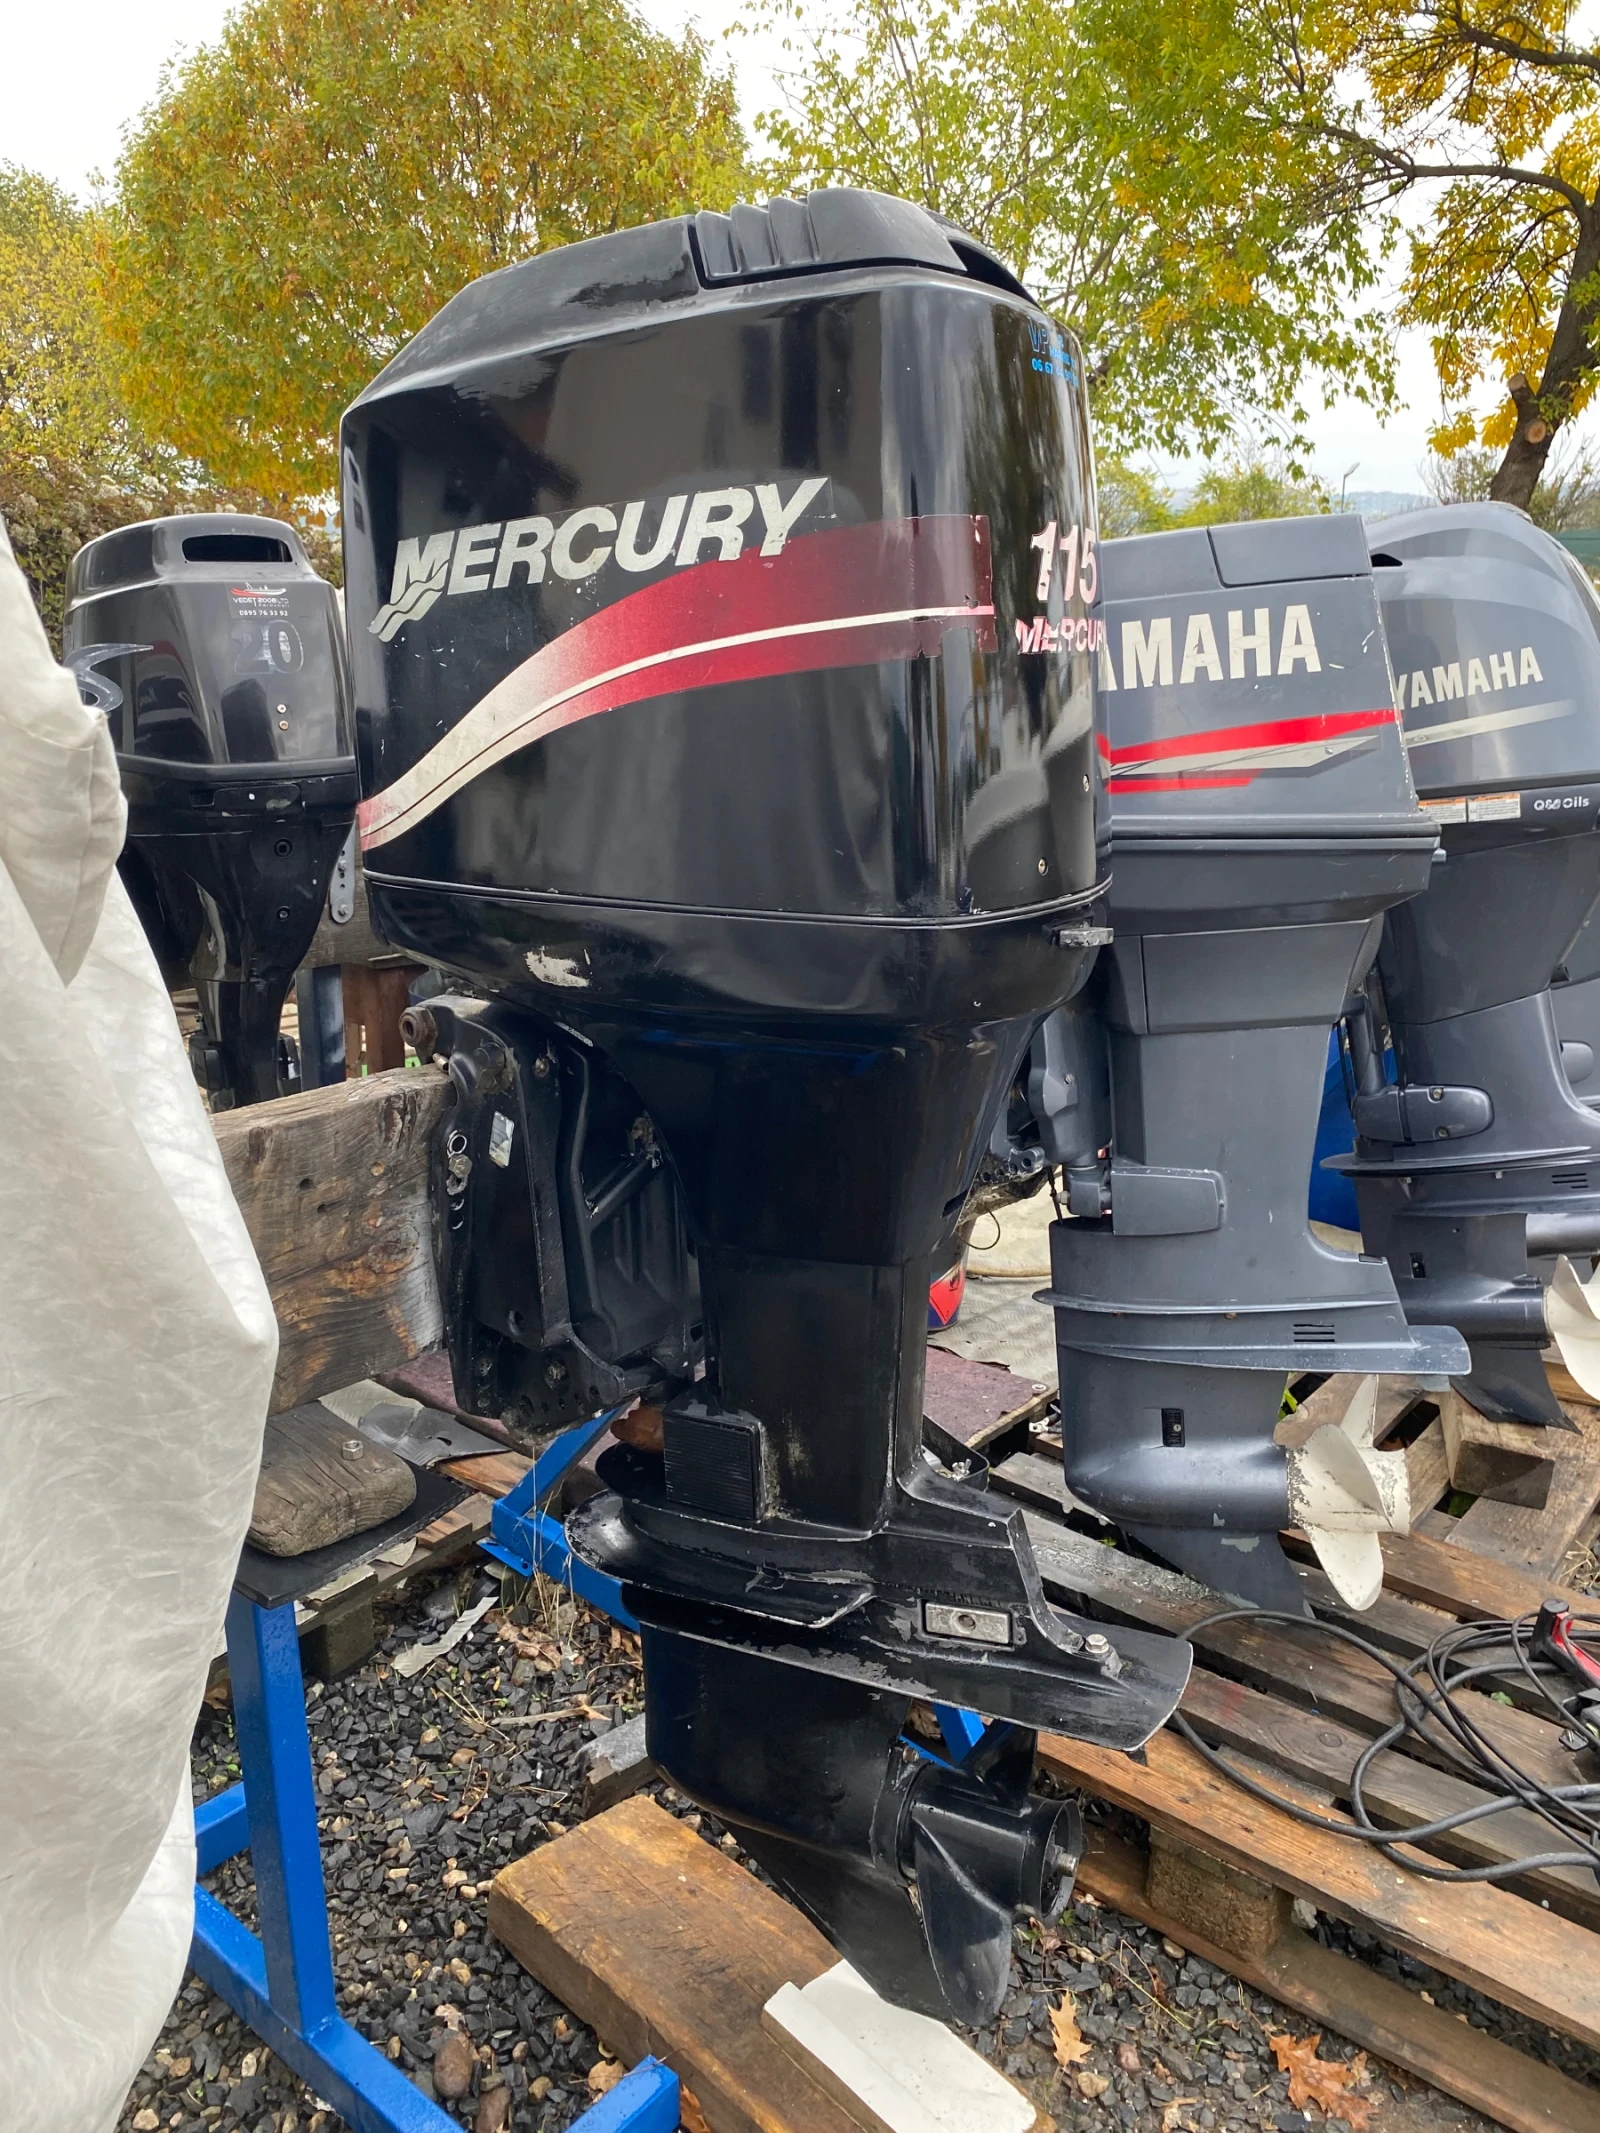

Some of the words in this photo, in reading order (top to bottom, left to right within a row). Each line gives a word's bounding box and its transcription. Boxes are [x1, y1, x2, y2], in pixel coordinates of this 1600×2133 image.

[367, 477, 829, 642] MERCURY
[1030, 521, 1098, 604] 115
[231, 619, 304, 675] 20
[1015, 615, 1107, 655] MERCUR
[1562, 795, 1590, 809] Oils
